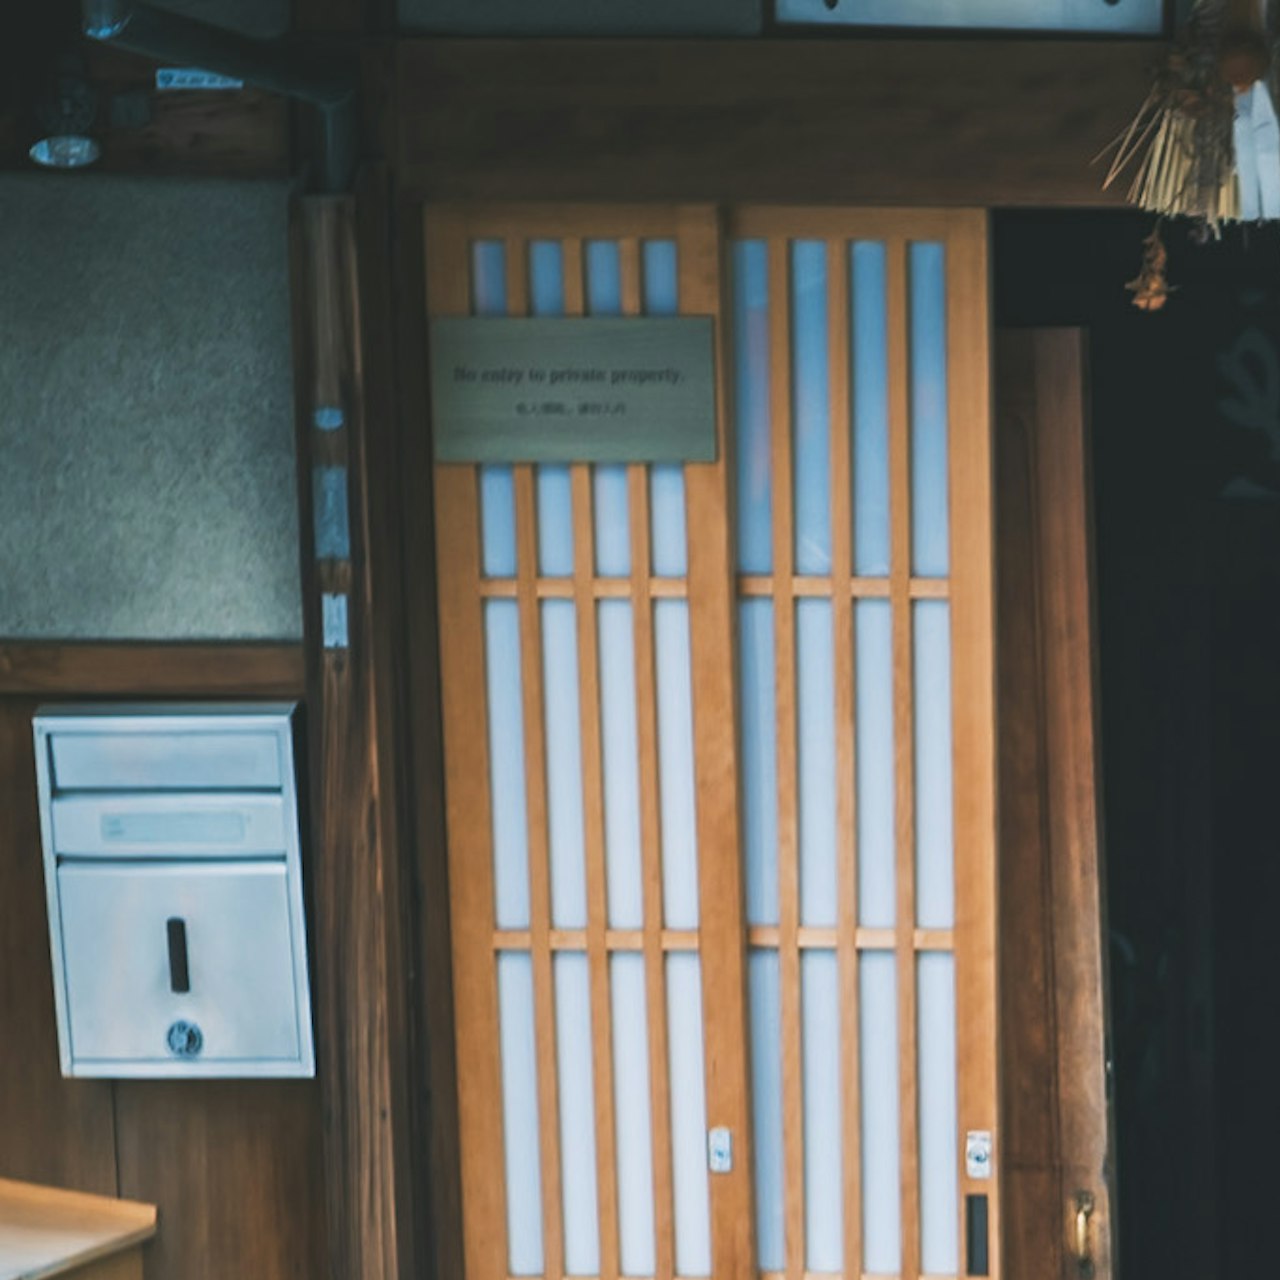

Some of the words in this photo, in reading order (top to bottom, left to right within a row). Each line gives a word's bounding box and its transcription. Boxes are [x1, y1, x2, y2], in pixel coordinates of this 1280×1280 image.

[453, 366, 477, 382] No
[481, 367, 524, 386] entry
[528, 368, 546, 382] to
[549, 367, 606, 385] private
